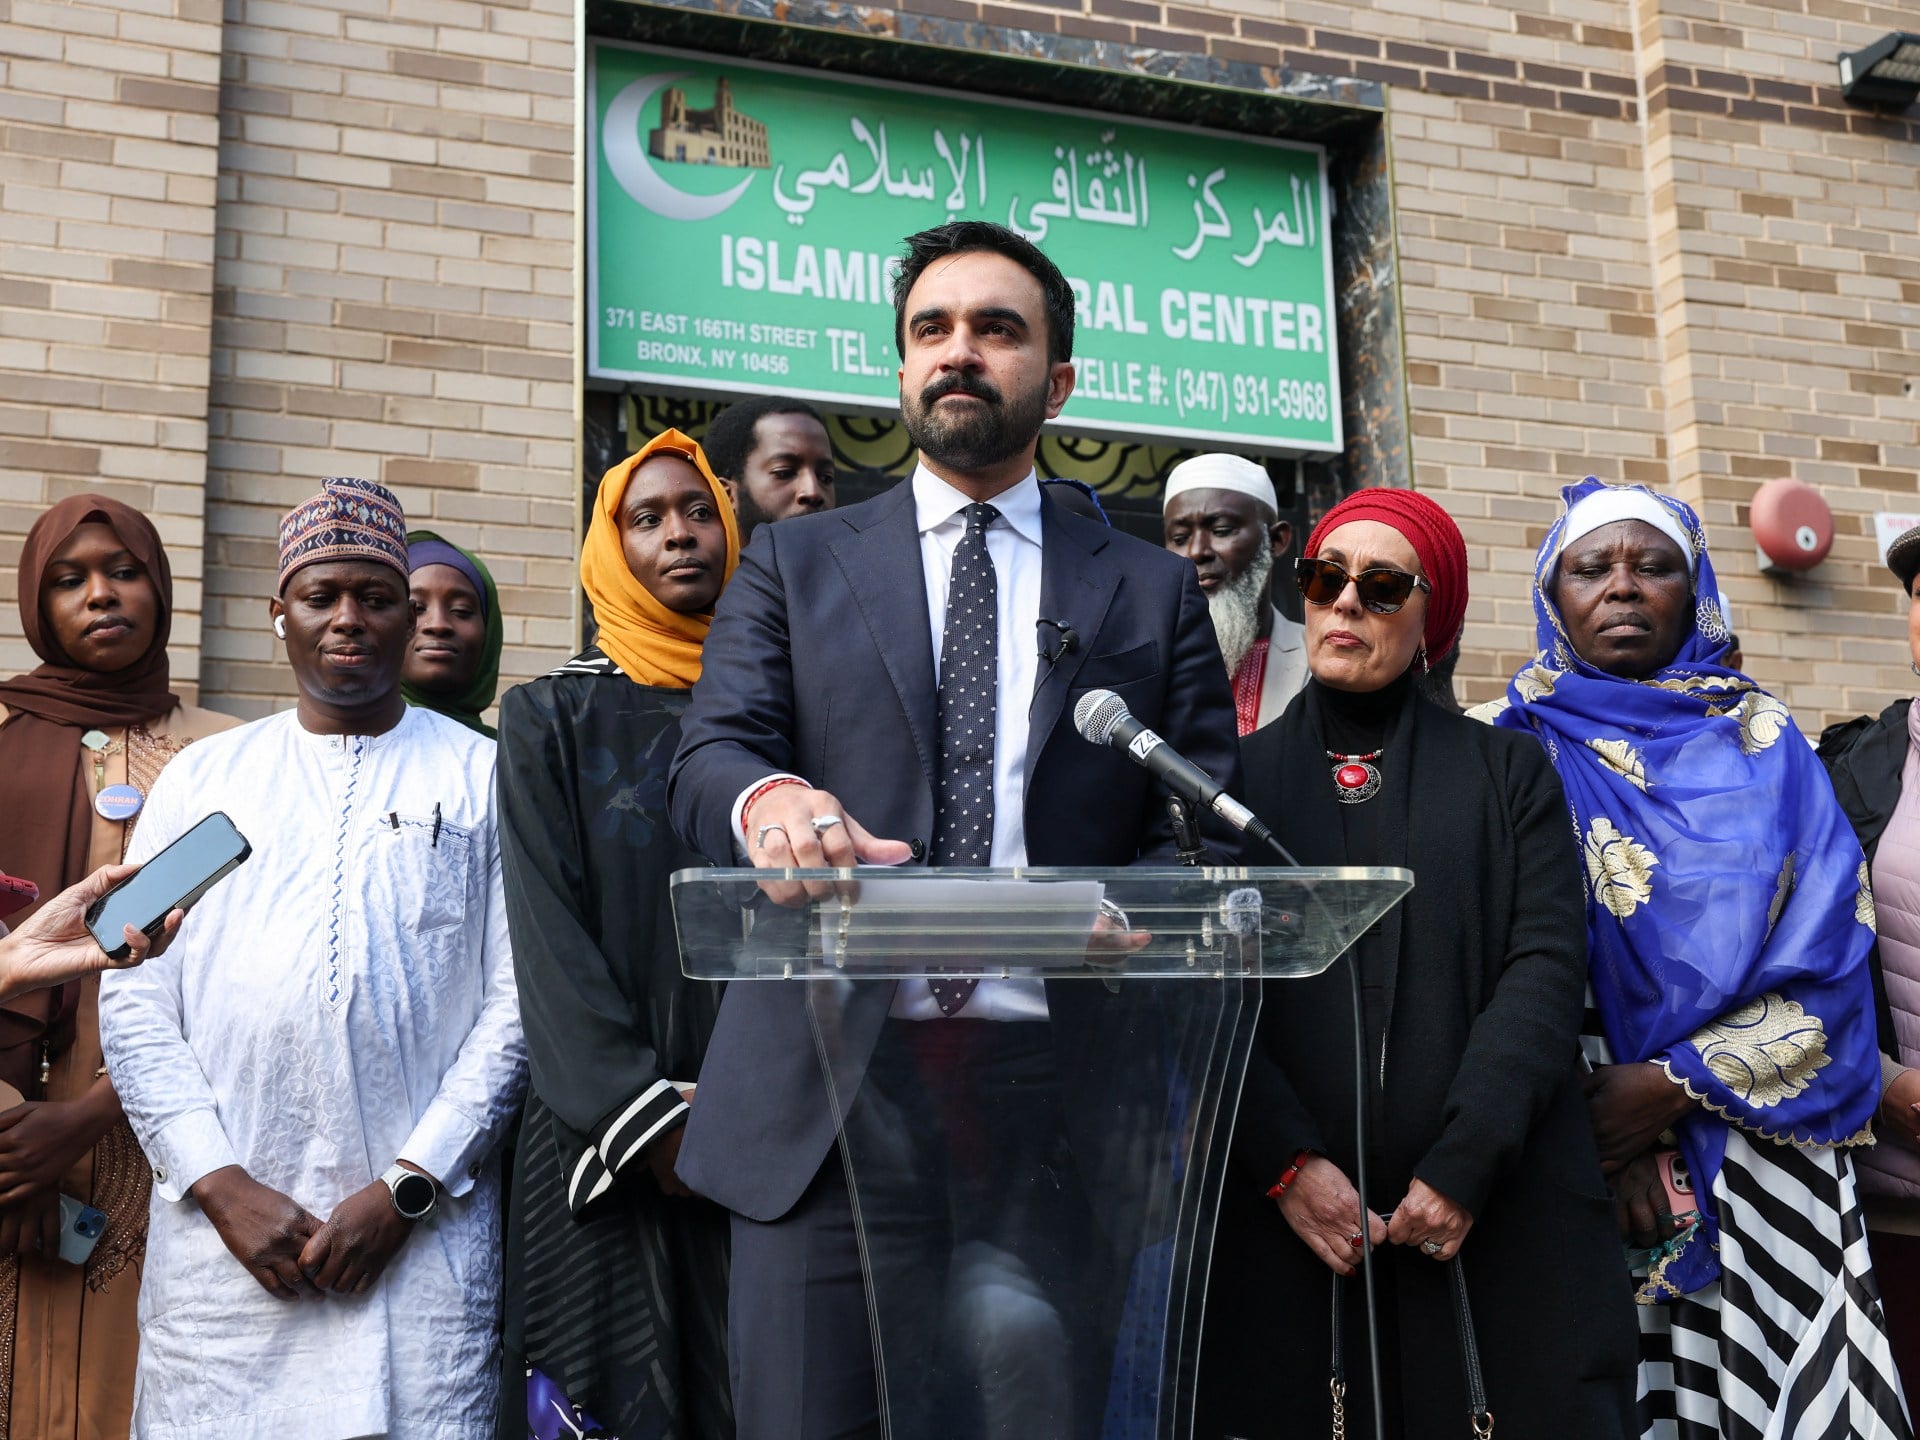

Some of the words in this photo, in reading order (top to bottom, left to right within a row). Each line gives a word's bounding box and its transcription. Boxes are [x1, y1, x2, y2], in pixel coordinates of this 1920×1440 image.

[1172, 167, 1317, 267] المركز
[606, 307, 634, 329] 371
[640, 311, 688, 335] EAST
[694, 319, 745, 341] 166TH
[750, 324, 817, 349] STREET
[1160, 288, 1323, 353] CENTER
[638, 340, 707, 368] BRONX,
[712, 349, 735, 369] NY
[741, 354, 789, 375] 10456
[1175, 367, 1229, 423] (347)
[1233, 374, 1328, 422] 931-5968
